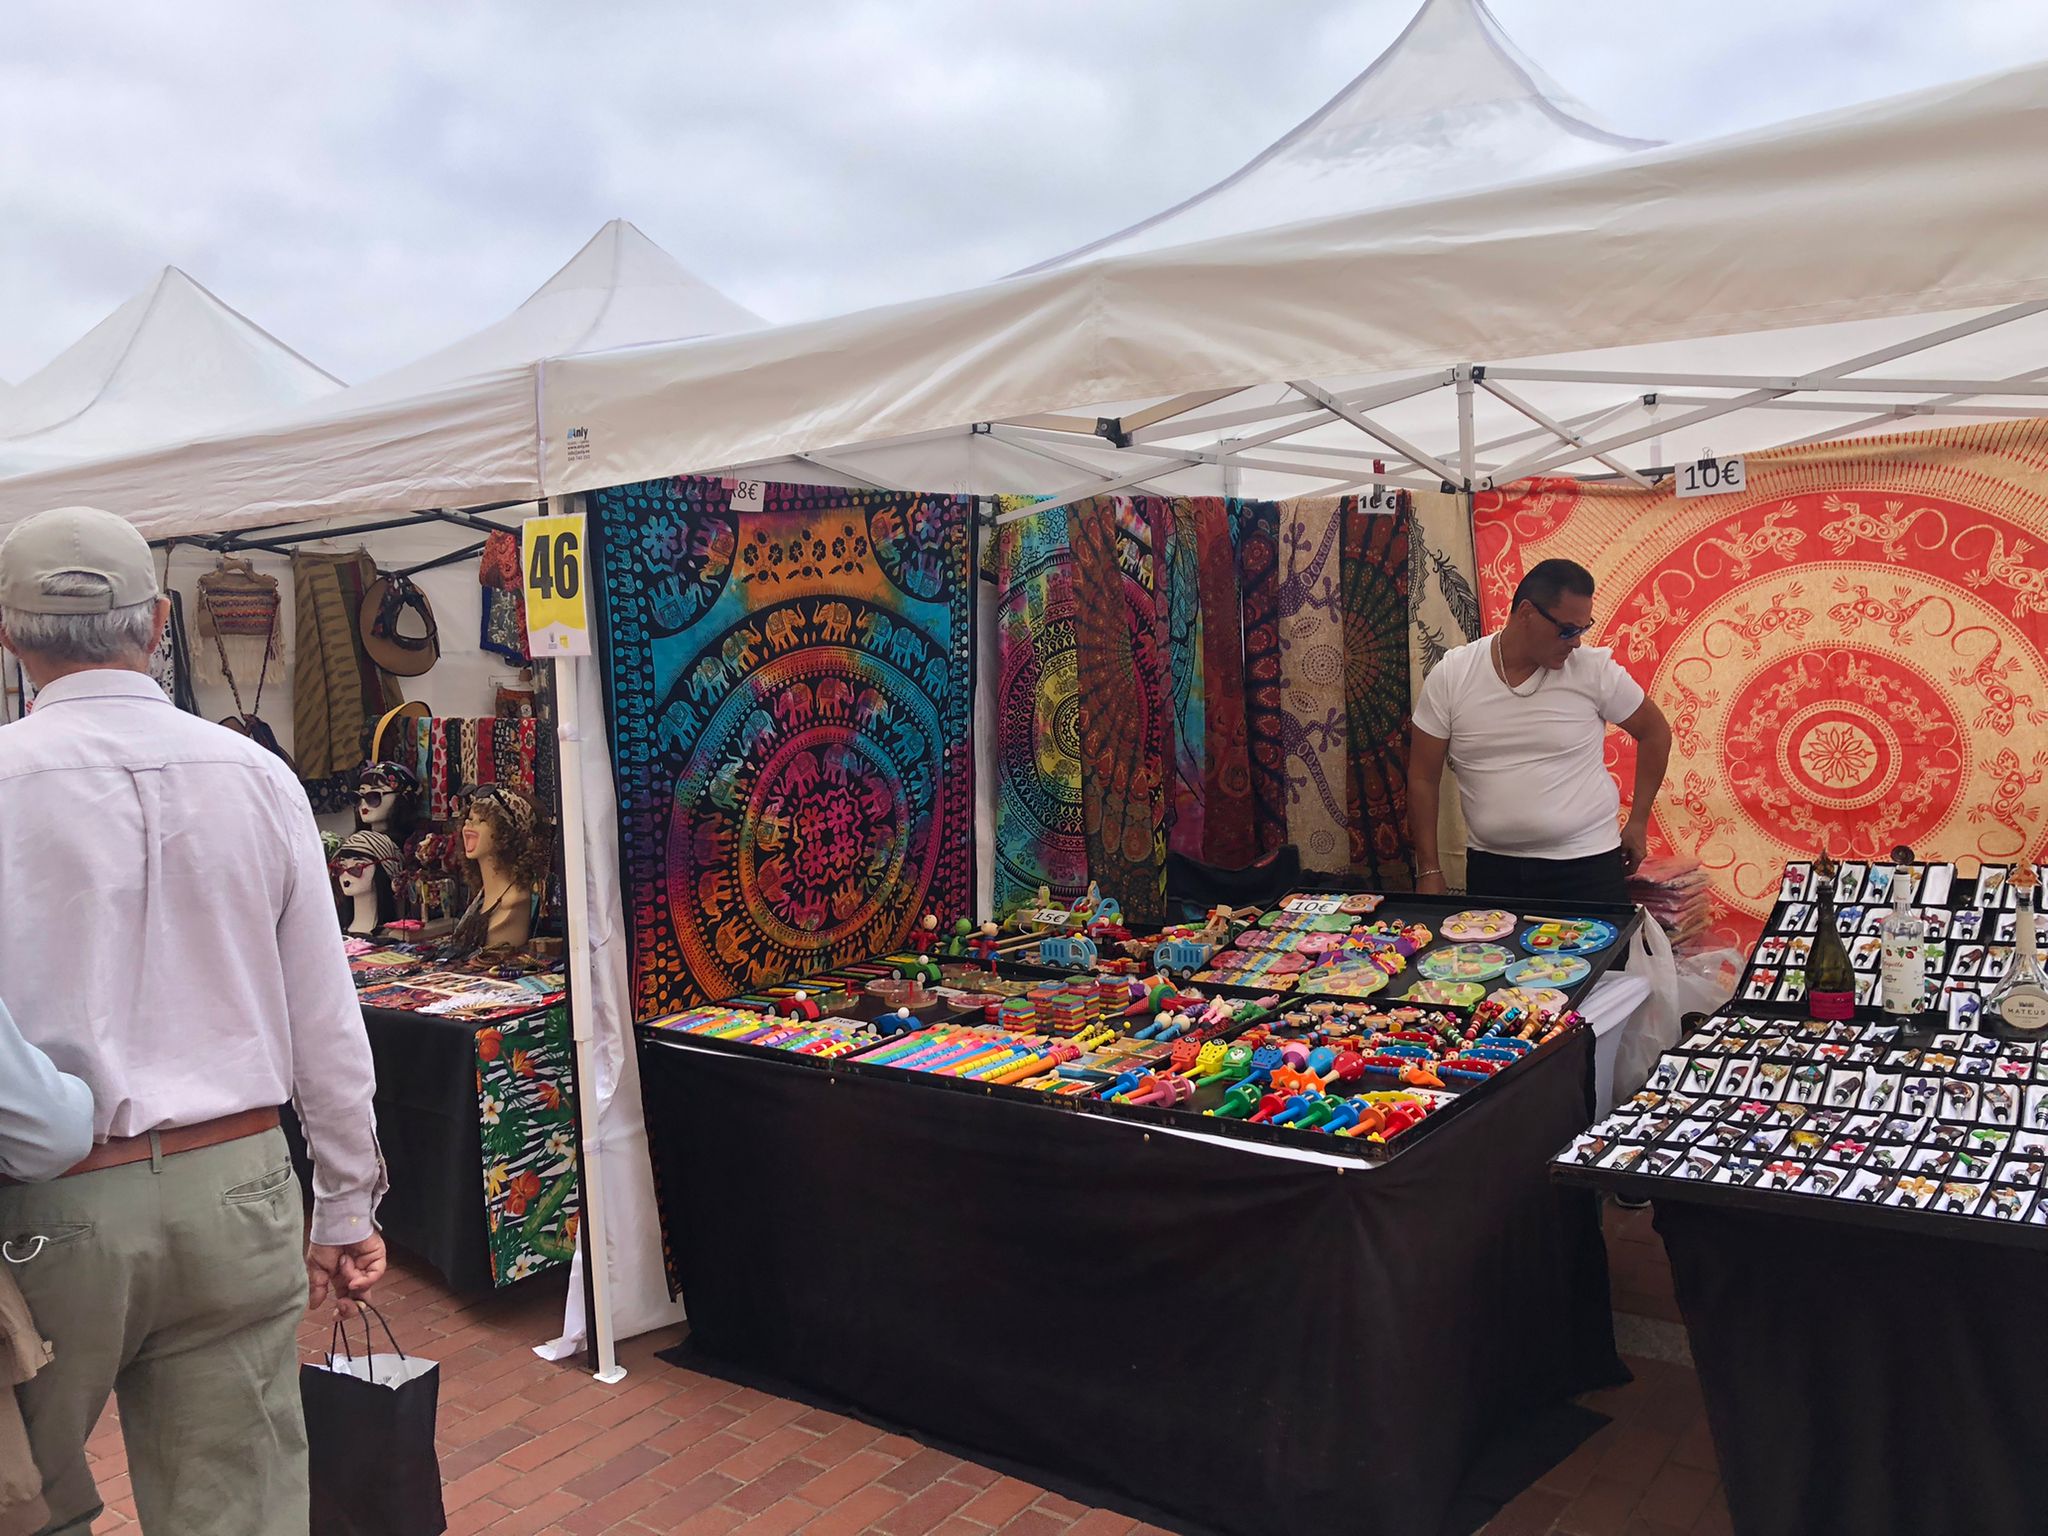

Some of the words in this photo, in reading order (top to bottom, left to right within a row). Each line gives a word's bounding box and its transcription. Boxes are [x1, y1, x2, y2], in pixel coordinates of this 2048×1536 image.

[1685, 460, 1740, 490] 10€
[530, 532, 579, 599] 46
[1291, 901, 1334, 912] 10€
[1034, 912, 1065, 922] 15€
[2007, 1008, 2046, 1016] MATEUS
